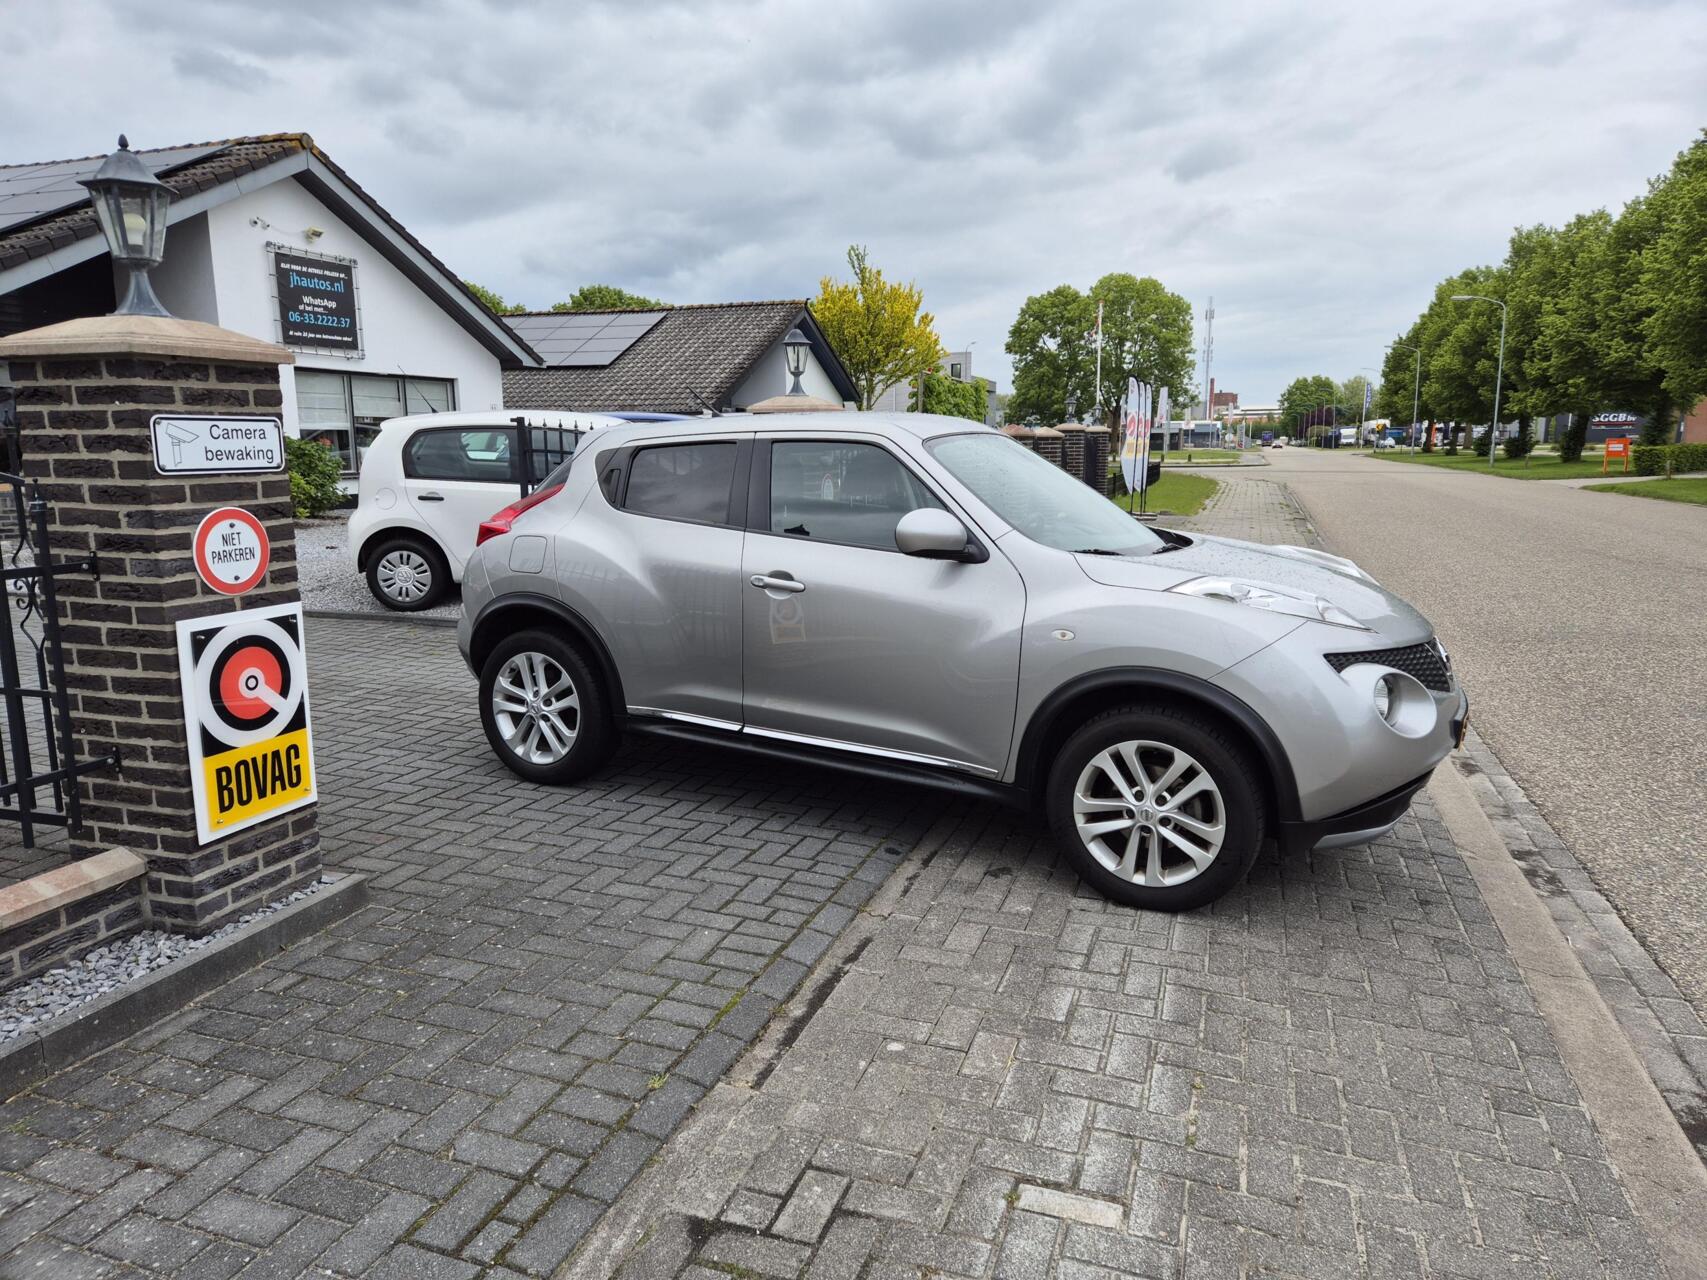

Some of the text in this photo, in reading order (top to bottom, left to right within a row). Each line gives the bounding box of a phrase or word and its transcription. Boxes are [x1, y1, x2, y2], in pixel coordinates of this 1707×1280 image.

[290, 272, 344, 292] jhautos.nl
[302, 295, 336, 308] WhatsApp
[288, 312, 350, 328] 06-33.2222.37
[209, 424, 266, 440] Camera
[204, 446, 274, 464] bewaking
[222, 532, 242, 547] NIET
[211, 547, 256, 565] PARKEREN
[215, 743, 302, 814] BOVAG
